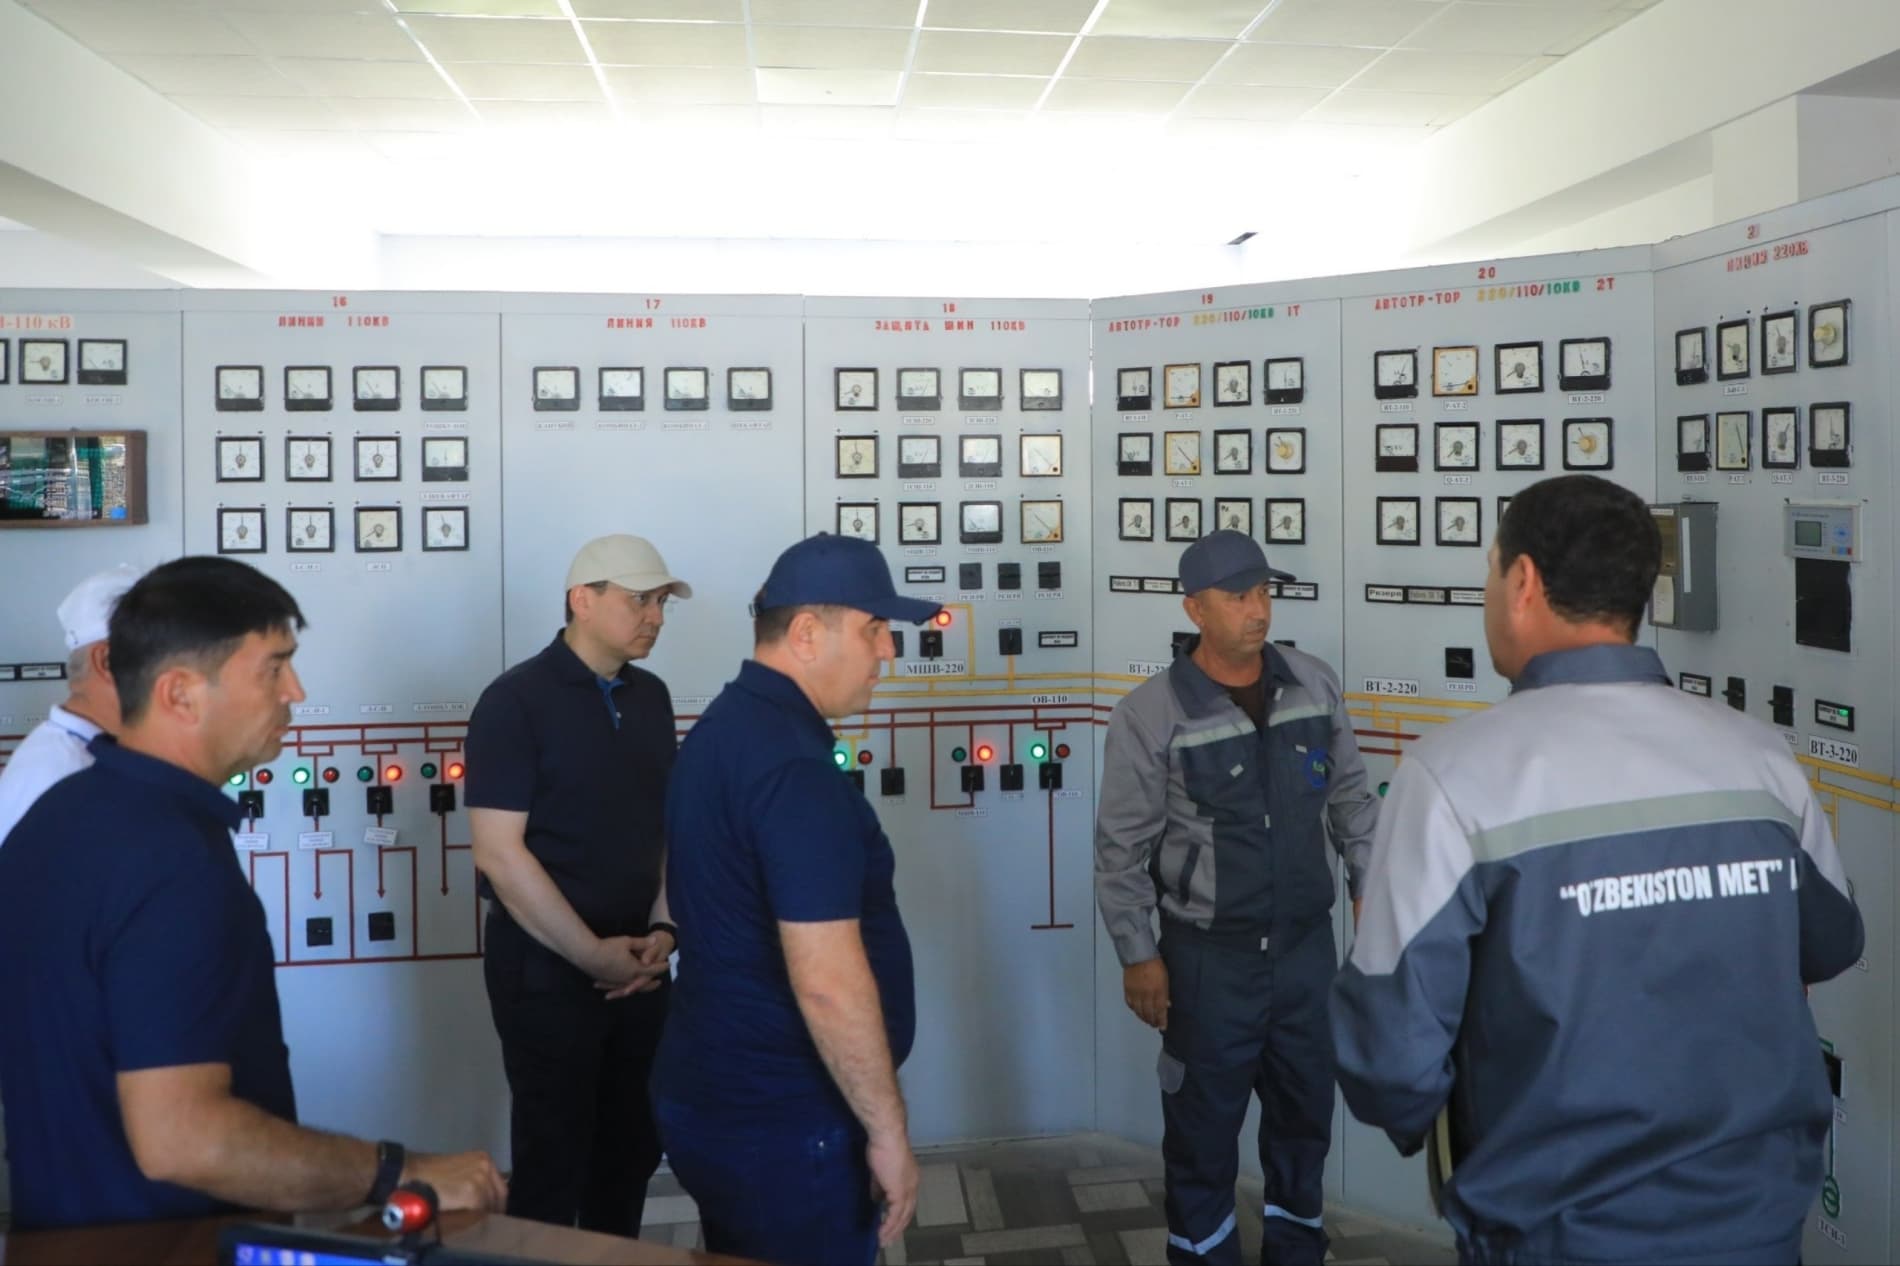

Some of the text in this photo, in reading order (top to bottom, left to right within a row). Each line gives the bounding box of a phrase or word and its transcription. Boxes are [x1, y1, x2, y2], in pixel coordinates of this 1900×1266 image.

[1478, 267, 1496, 279] 20
[333, 296, 348, 308] 16
[646, 299, 661, 309] 17
[1201, 293, 1214, 305] 19
[943, 303, 956, 313] 18
[607, 318, 654, 328] ЛИНИЯ
[875, 320, 930, 332] ЗАЩИТА
[944, 320, 974, 331] ШИН
[1365, 680, 1417, 694] ВТ-2-220
[1810, 739, 1858, 765] ВТ-3-220
